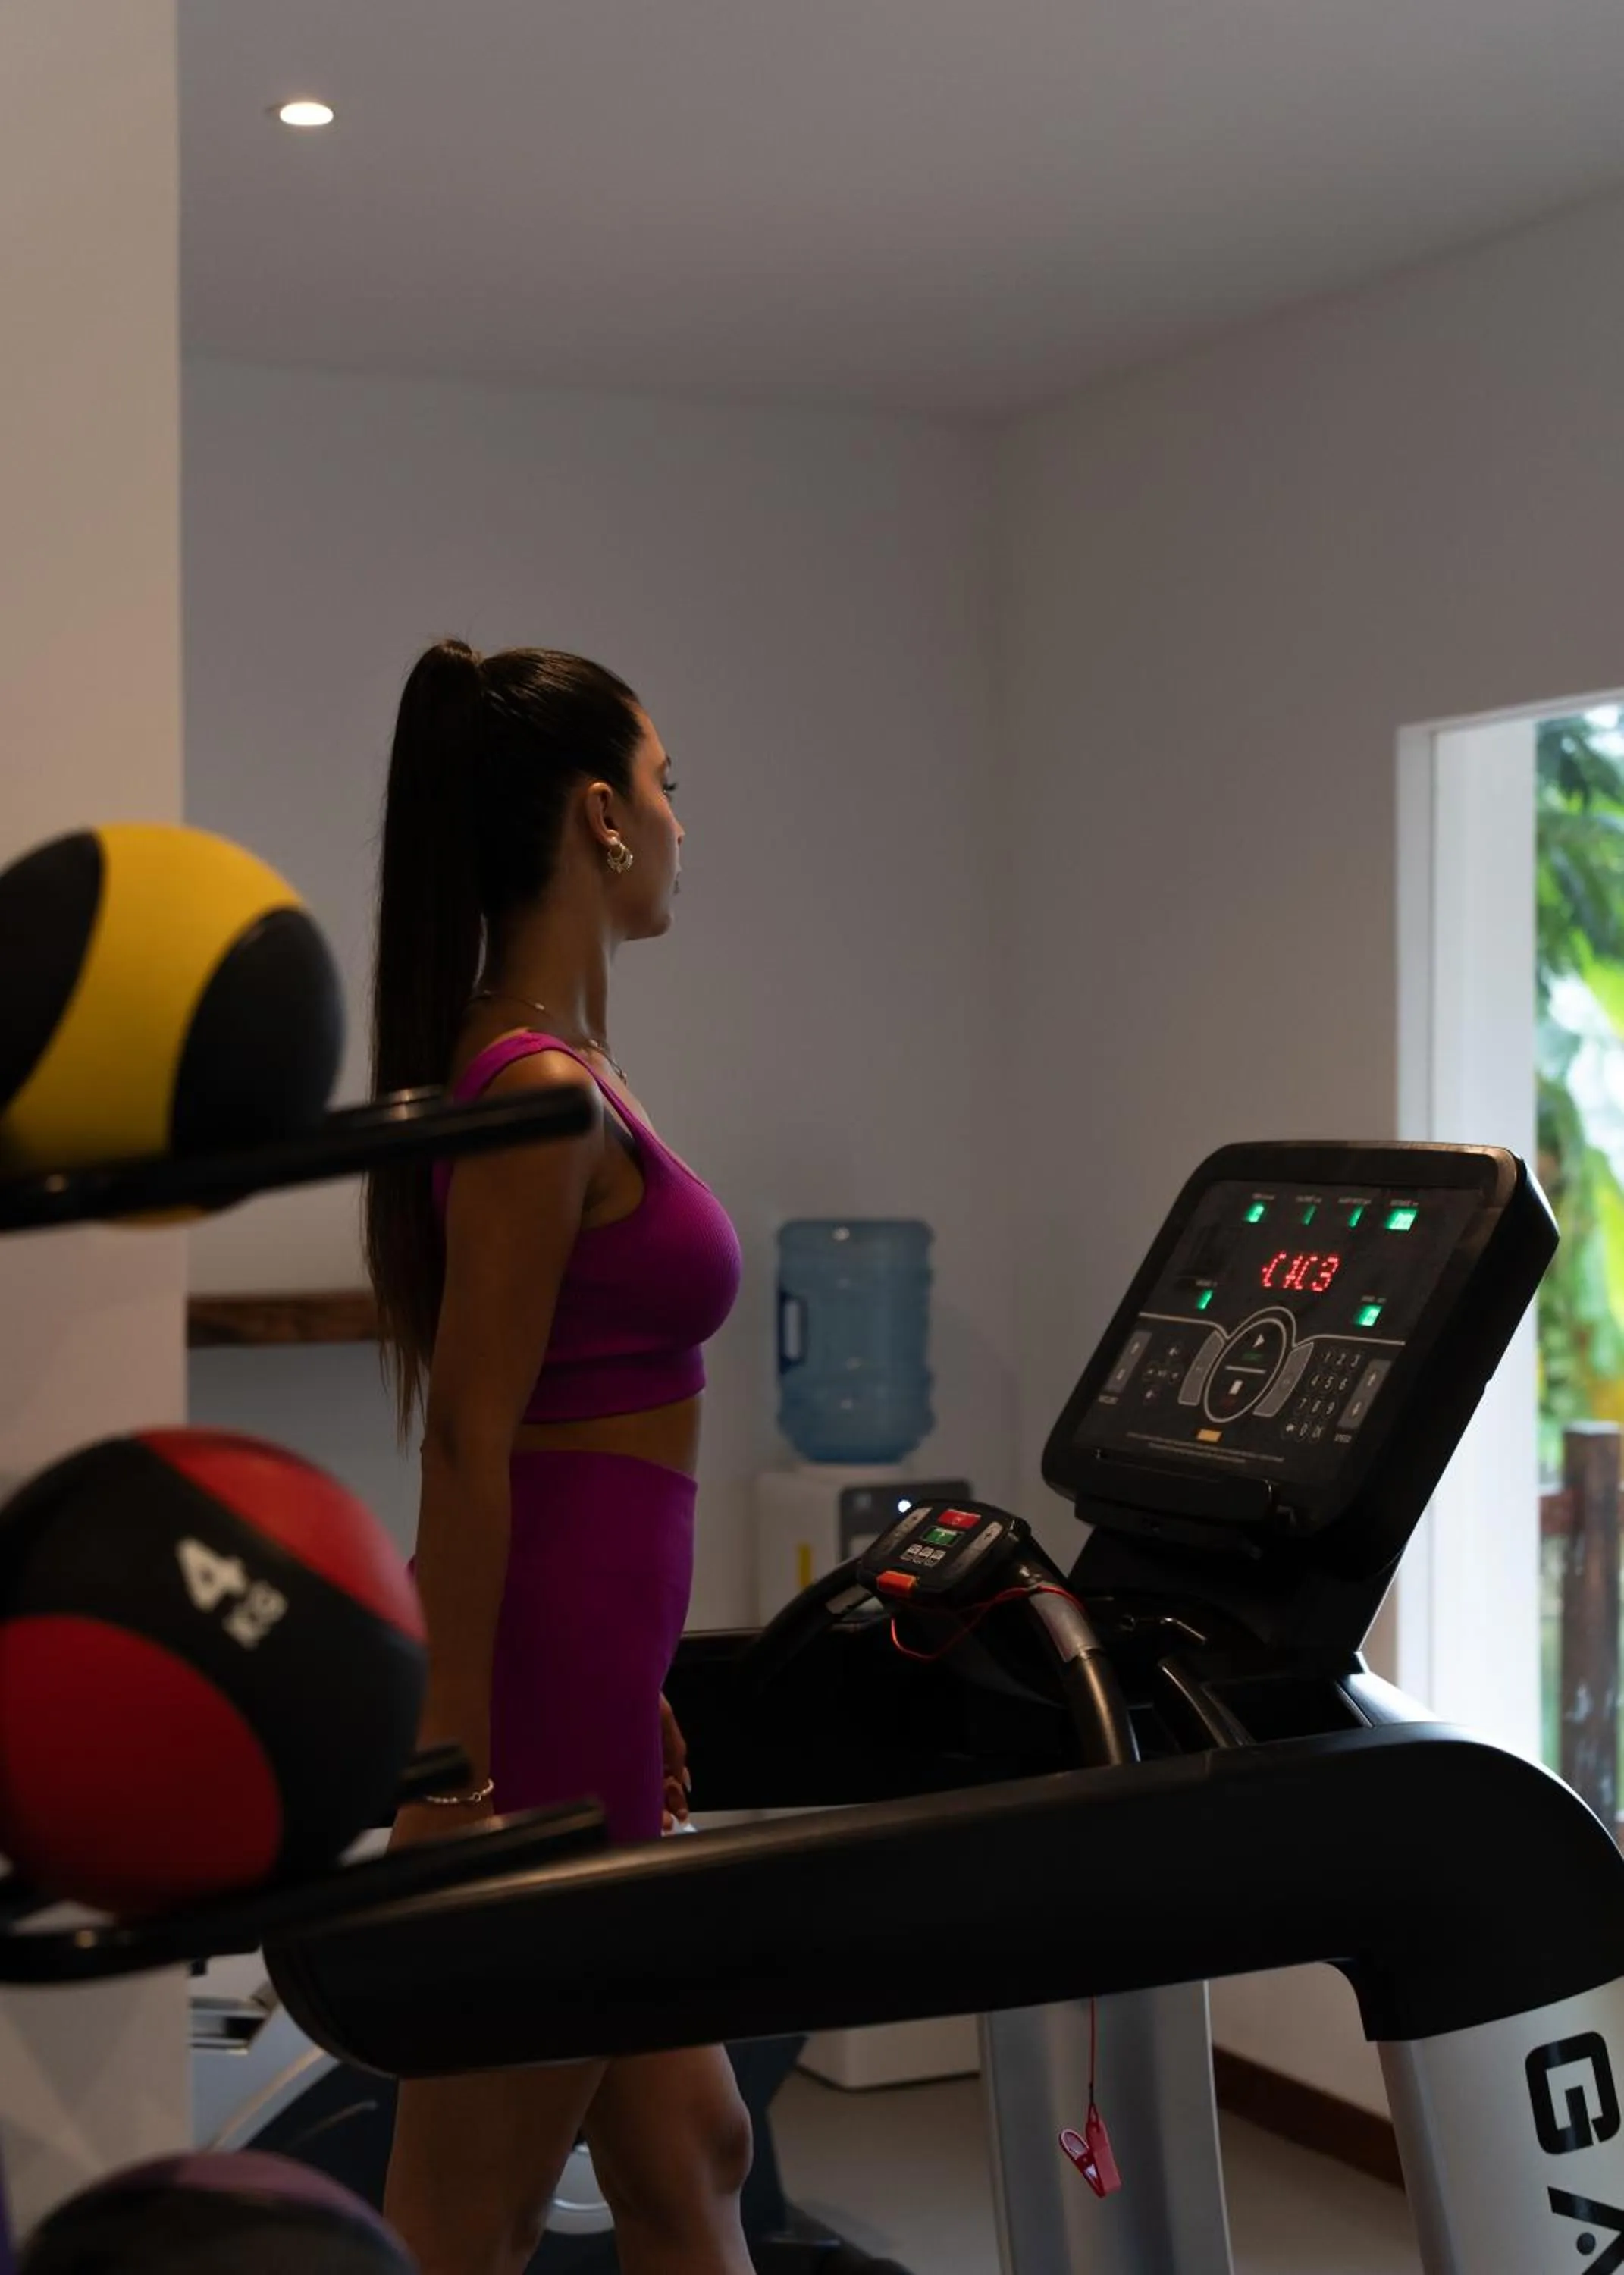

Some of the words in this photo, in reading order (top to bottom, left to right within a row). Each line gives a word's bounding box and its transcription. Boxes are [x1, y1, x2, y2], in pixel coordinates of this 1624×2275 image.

[1336, 1353, 1346, 1365] 2
[1324, 1376, 1334, 1389] 5
[176, 1536, 247, 1613] 4
